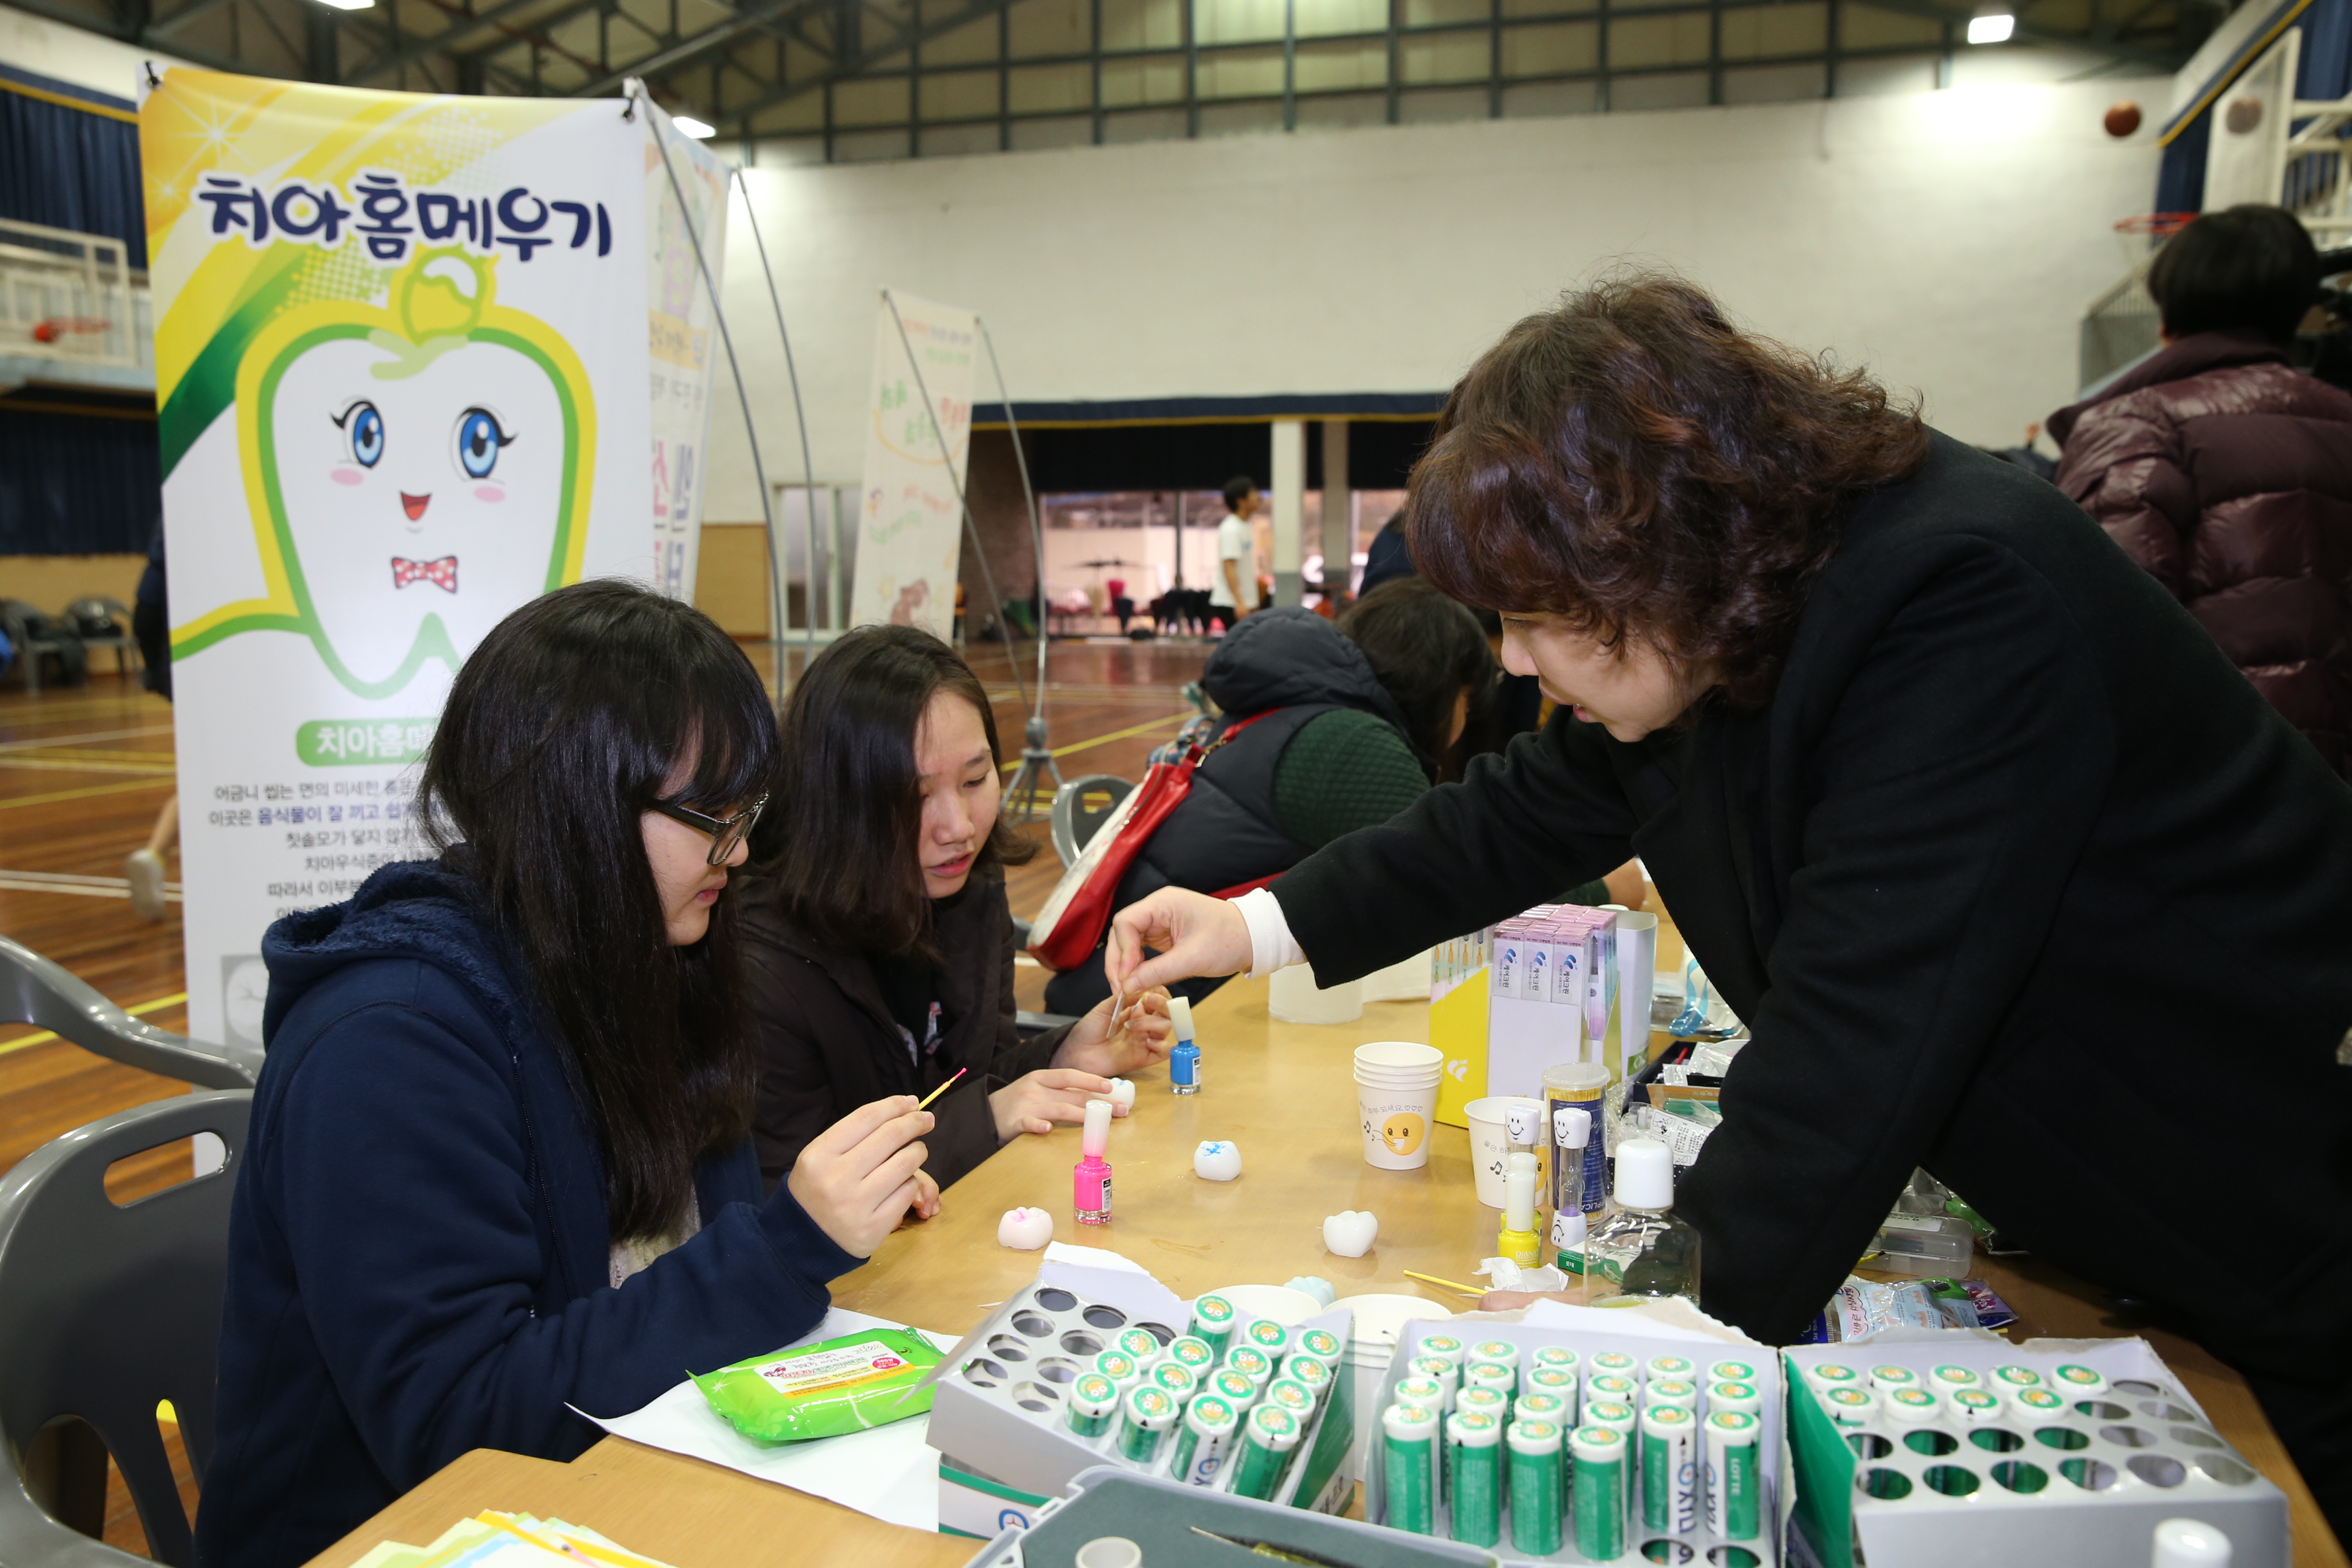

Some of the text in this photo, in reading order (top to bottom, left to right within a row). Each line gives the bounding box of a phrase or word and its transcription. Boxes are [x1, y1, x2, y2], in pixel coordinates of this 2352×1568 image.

[199, 174, 610, 261] 치아홈메우기
[214, 784, 259, 802] 어금니
[264, 783, 295, 801] 씹는
[210, 809, 252, 826] 이곳은
[258, 805, 321, 826] 음식물이
[328, 805, 342, 822] 잘
[287, 832, 346, 849] 칫솔모가
[350, 829, 380, 845] 닿지
[267, 882, 313, 898] 따라서
[1380, 1105, 1403, 1113] 되세요
[1731, 1458, 1742, 1497] LOTTE
